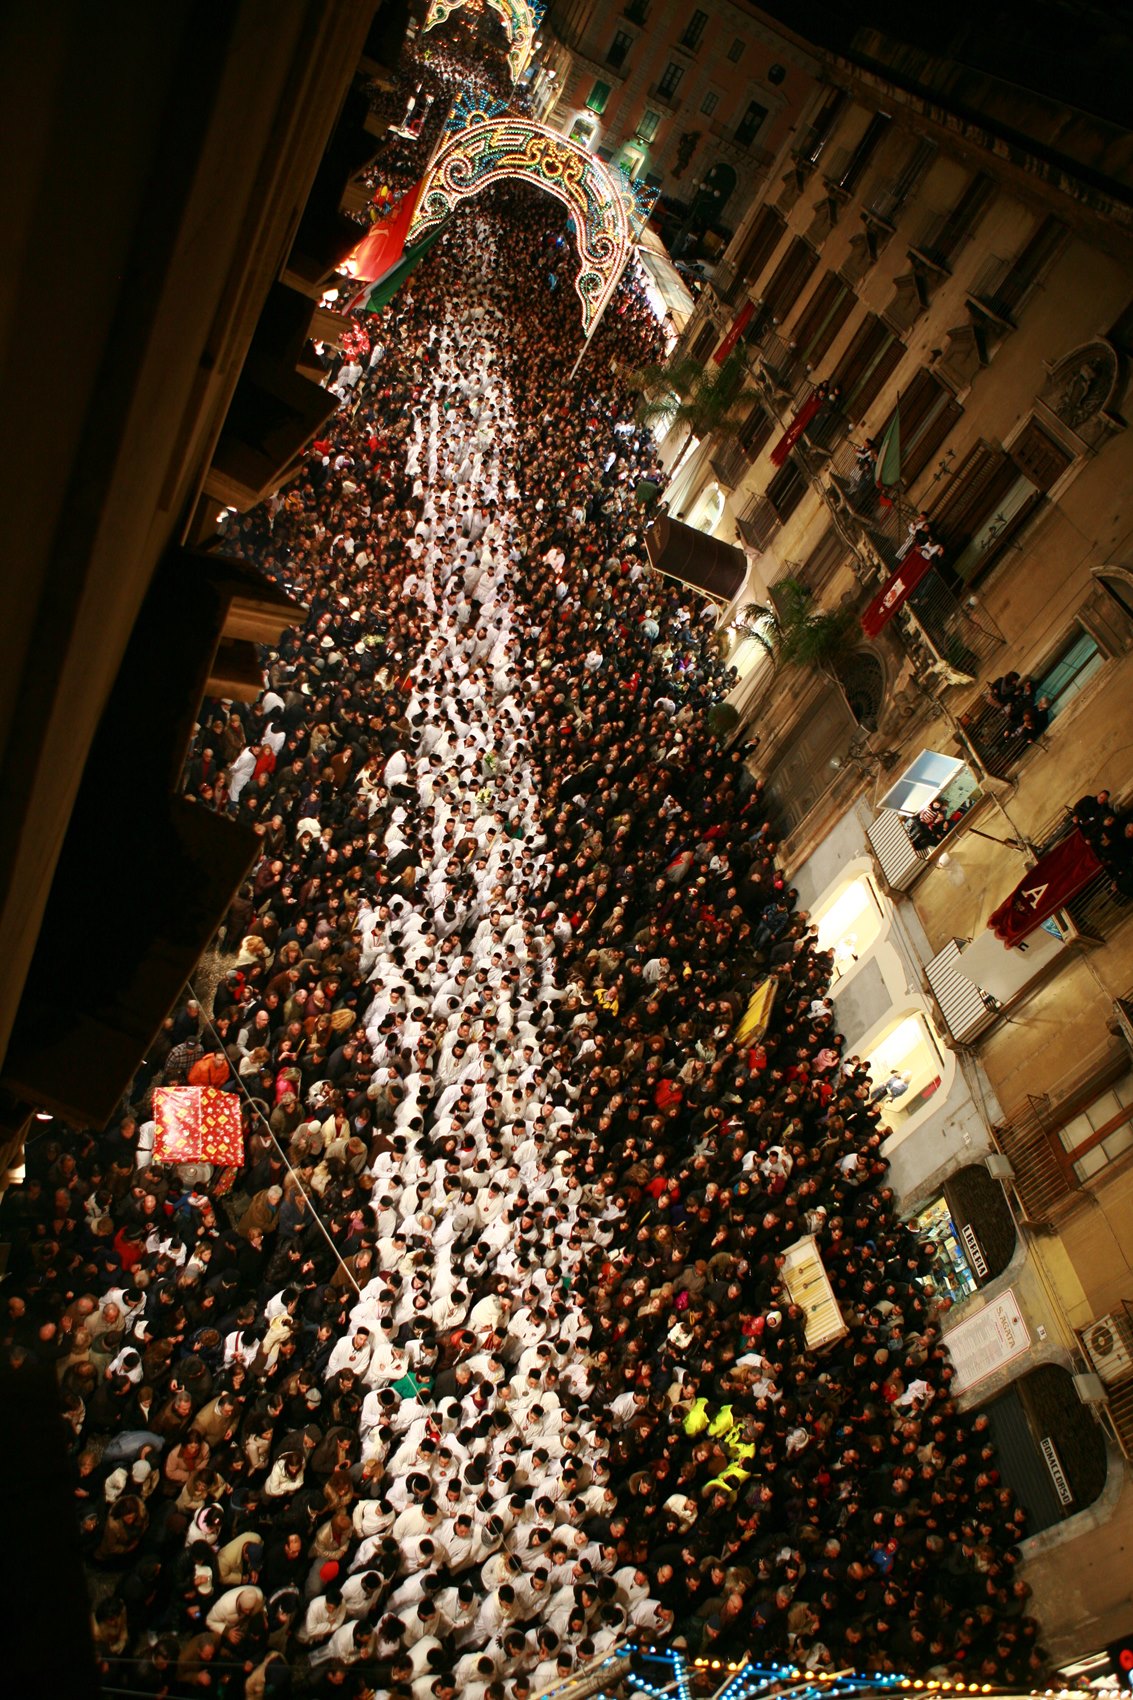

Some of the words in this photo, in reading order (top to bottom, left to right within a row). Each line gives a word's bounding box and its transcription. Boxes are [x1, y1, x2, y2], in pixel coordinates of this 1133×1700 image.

[1021, 883, 1049, 909] A
[963, 1226, 986, 1274] LIBRERIA
[1000, 1316, 1015, 1349] AGATA
[1042, 1440, 1071, 1503] BONACCORSO
